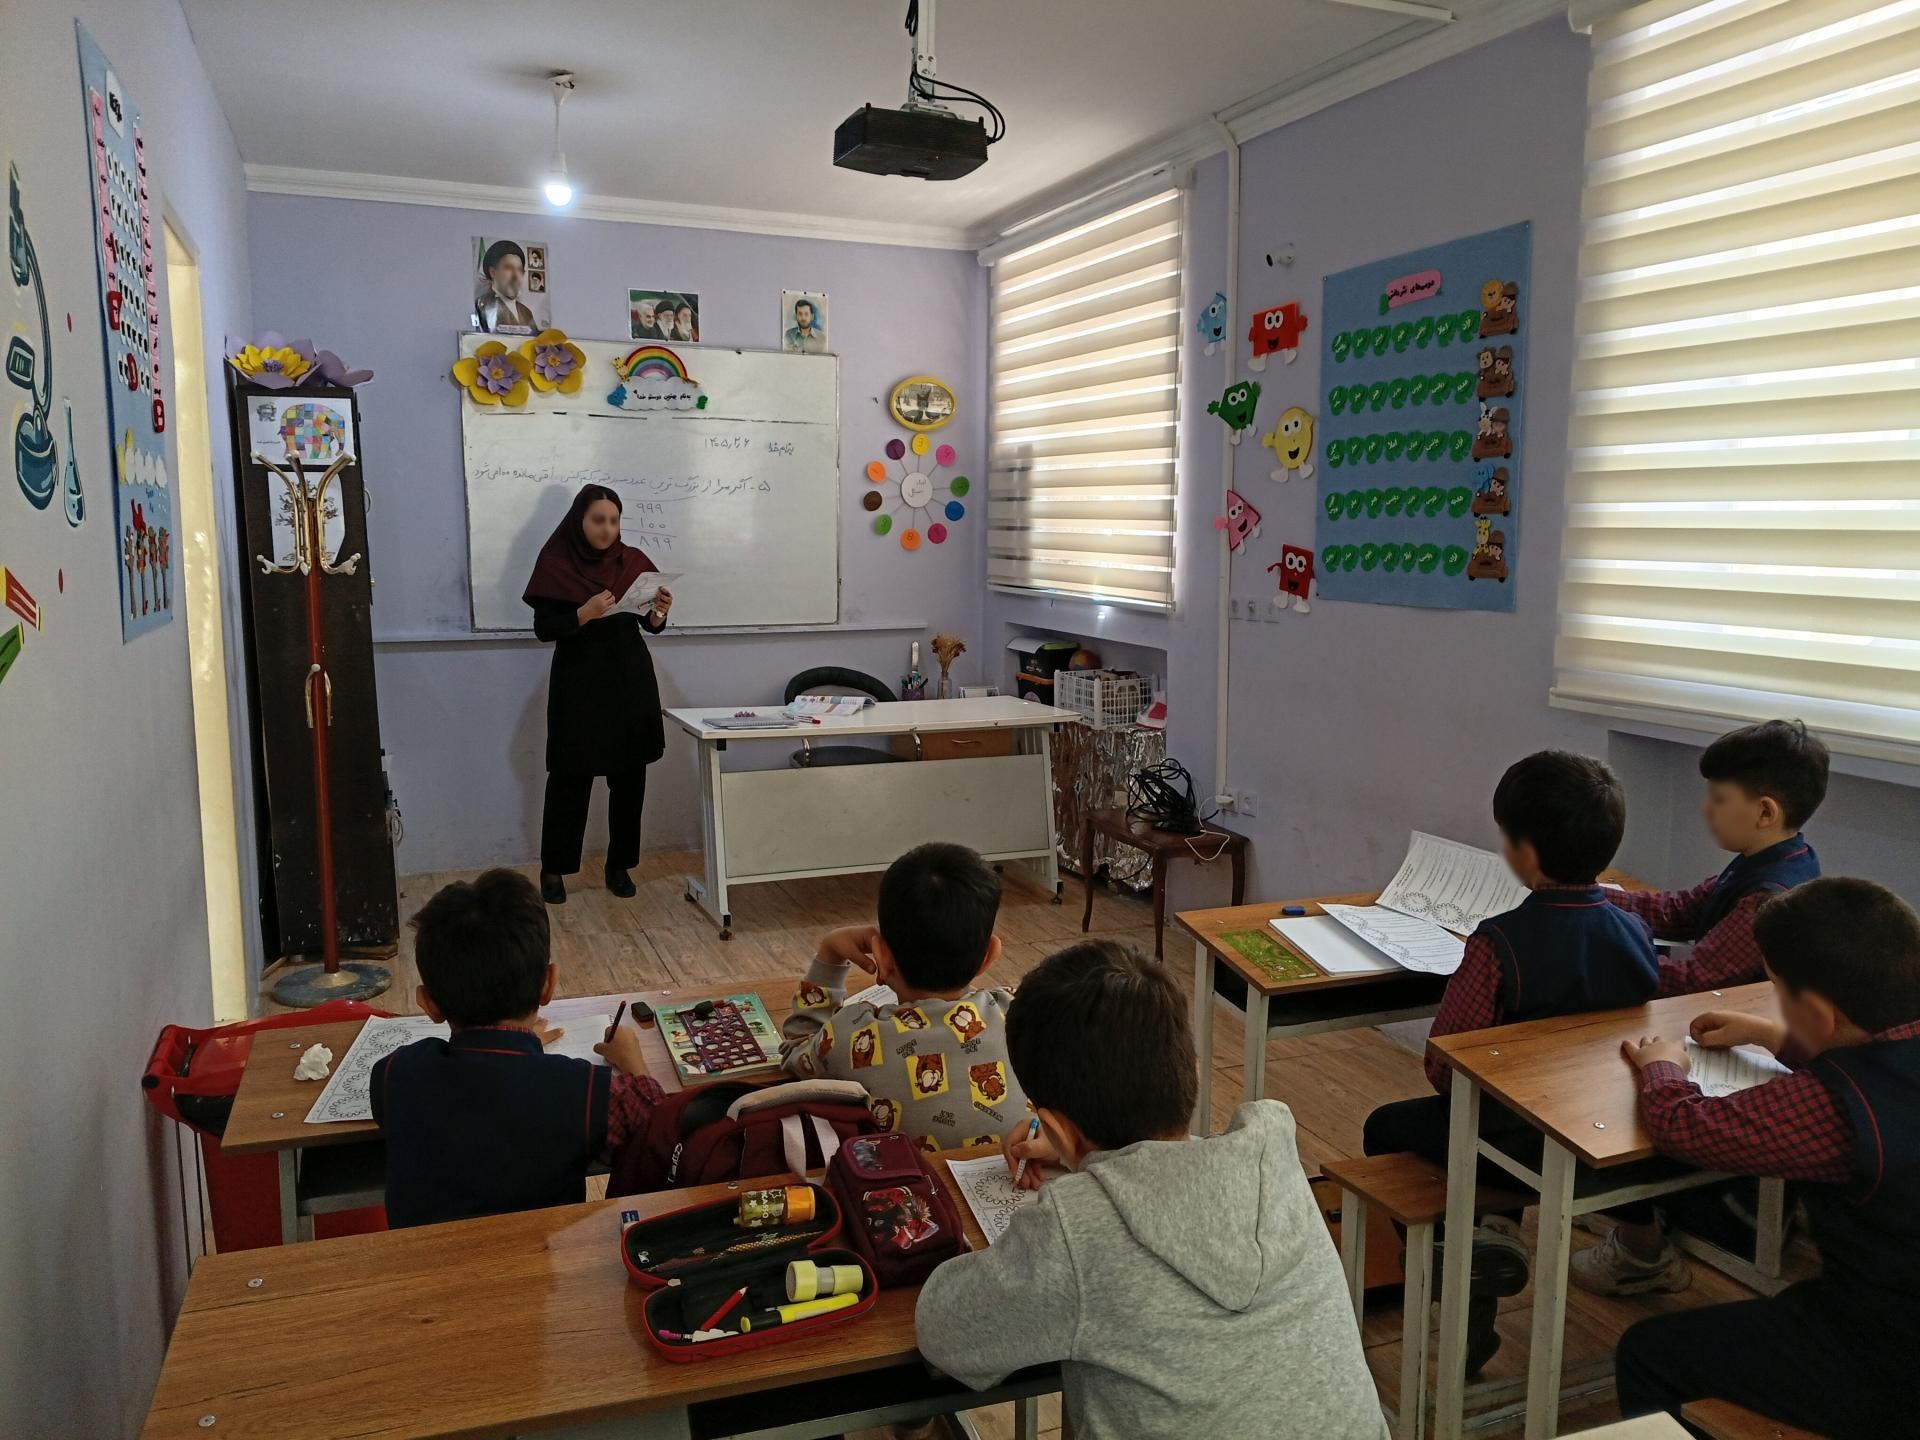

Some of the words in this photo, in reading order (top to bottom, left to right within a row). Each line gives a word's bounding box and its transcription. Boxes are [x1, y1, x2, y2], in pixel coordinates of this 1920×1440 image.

[635, 502, 664, 515] ۹۹۹
[639, 516, 667, 530] ۱۰۰
[639, 535, 673, 552] ۸۹۹
